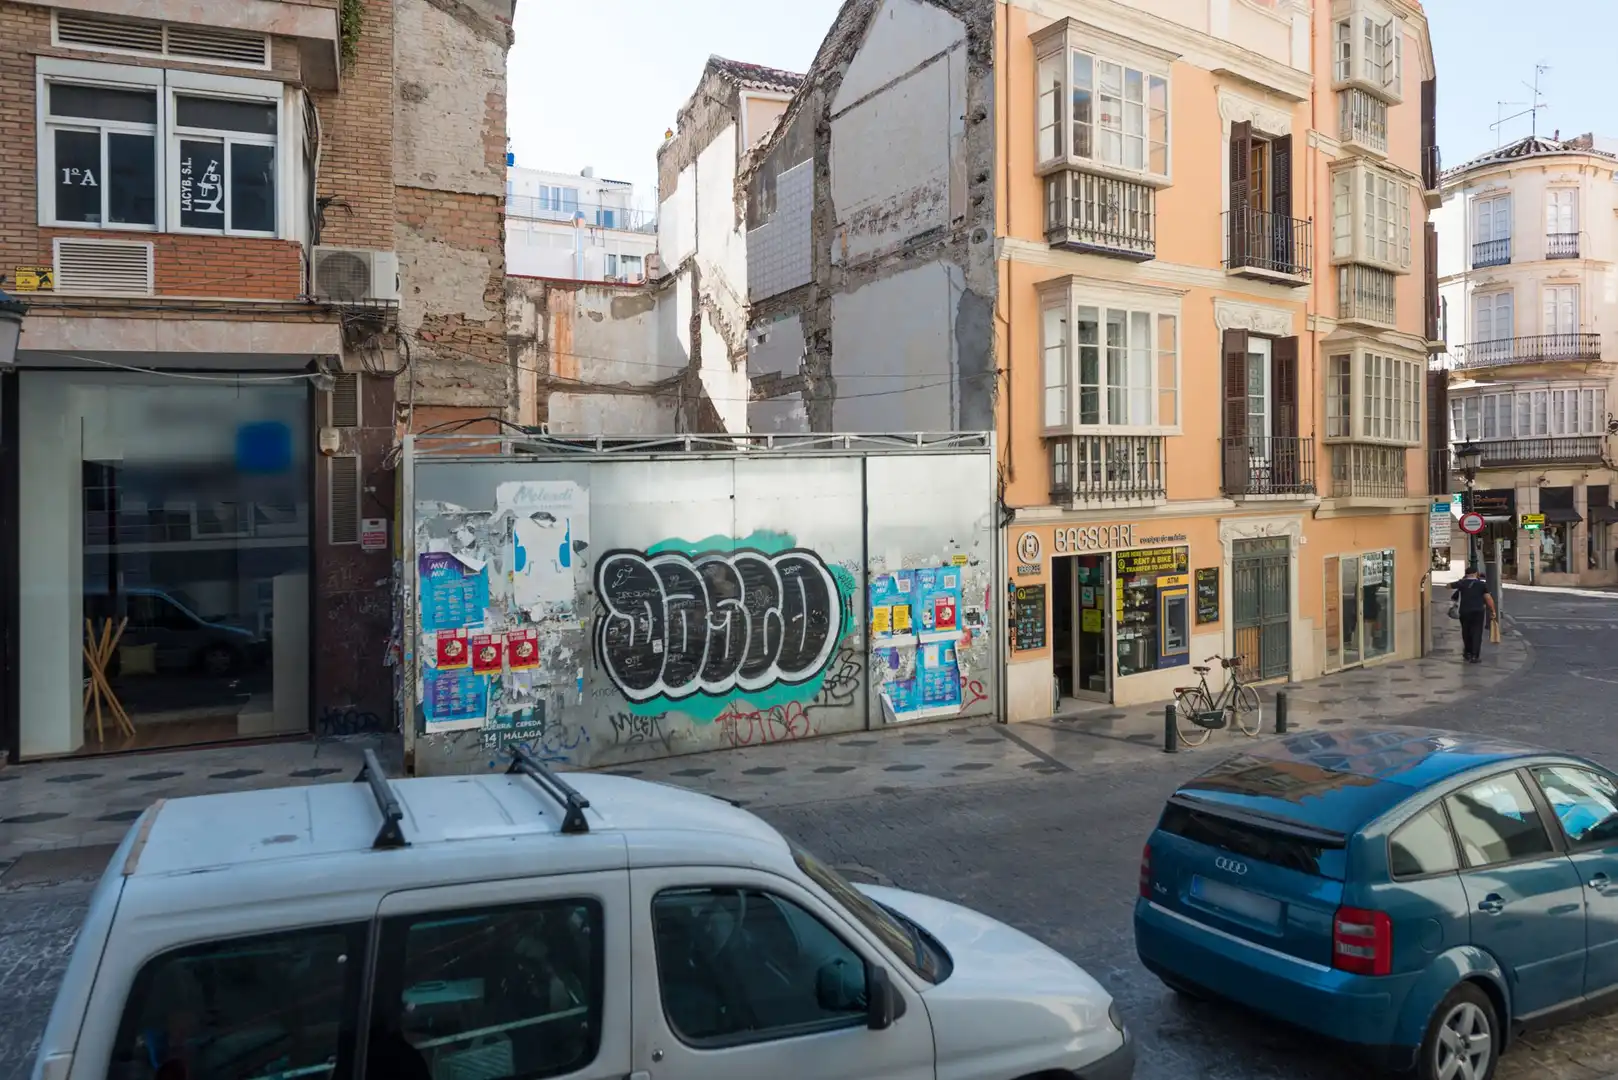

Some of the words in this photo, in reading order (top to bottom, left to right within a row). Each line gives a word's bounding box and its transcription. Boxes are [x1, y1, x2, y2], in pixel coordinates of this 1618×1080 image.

[181, 157, 193, 176] S.L.
[181, 178, 193, 211] LACYB,
[1054, 524, 1139, 552] BAGSCARE
[1133, 557, 1150, 565] RENT
[1157, 555, 1172, 563] BIKE
[1126, 565, 1151, 573] TRANSFER
[515, 720, 542, 728] CEPEDA
[483, 733, 497, 742] 14
[503, 730, 542, 740] MÁLAGA
